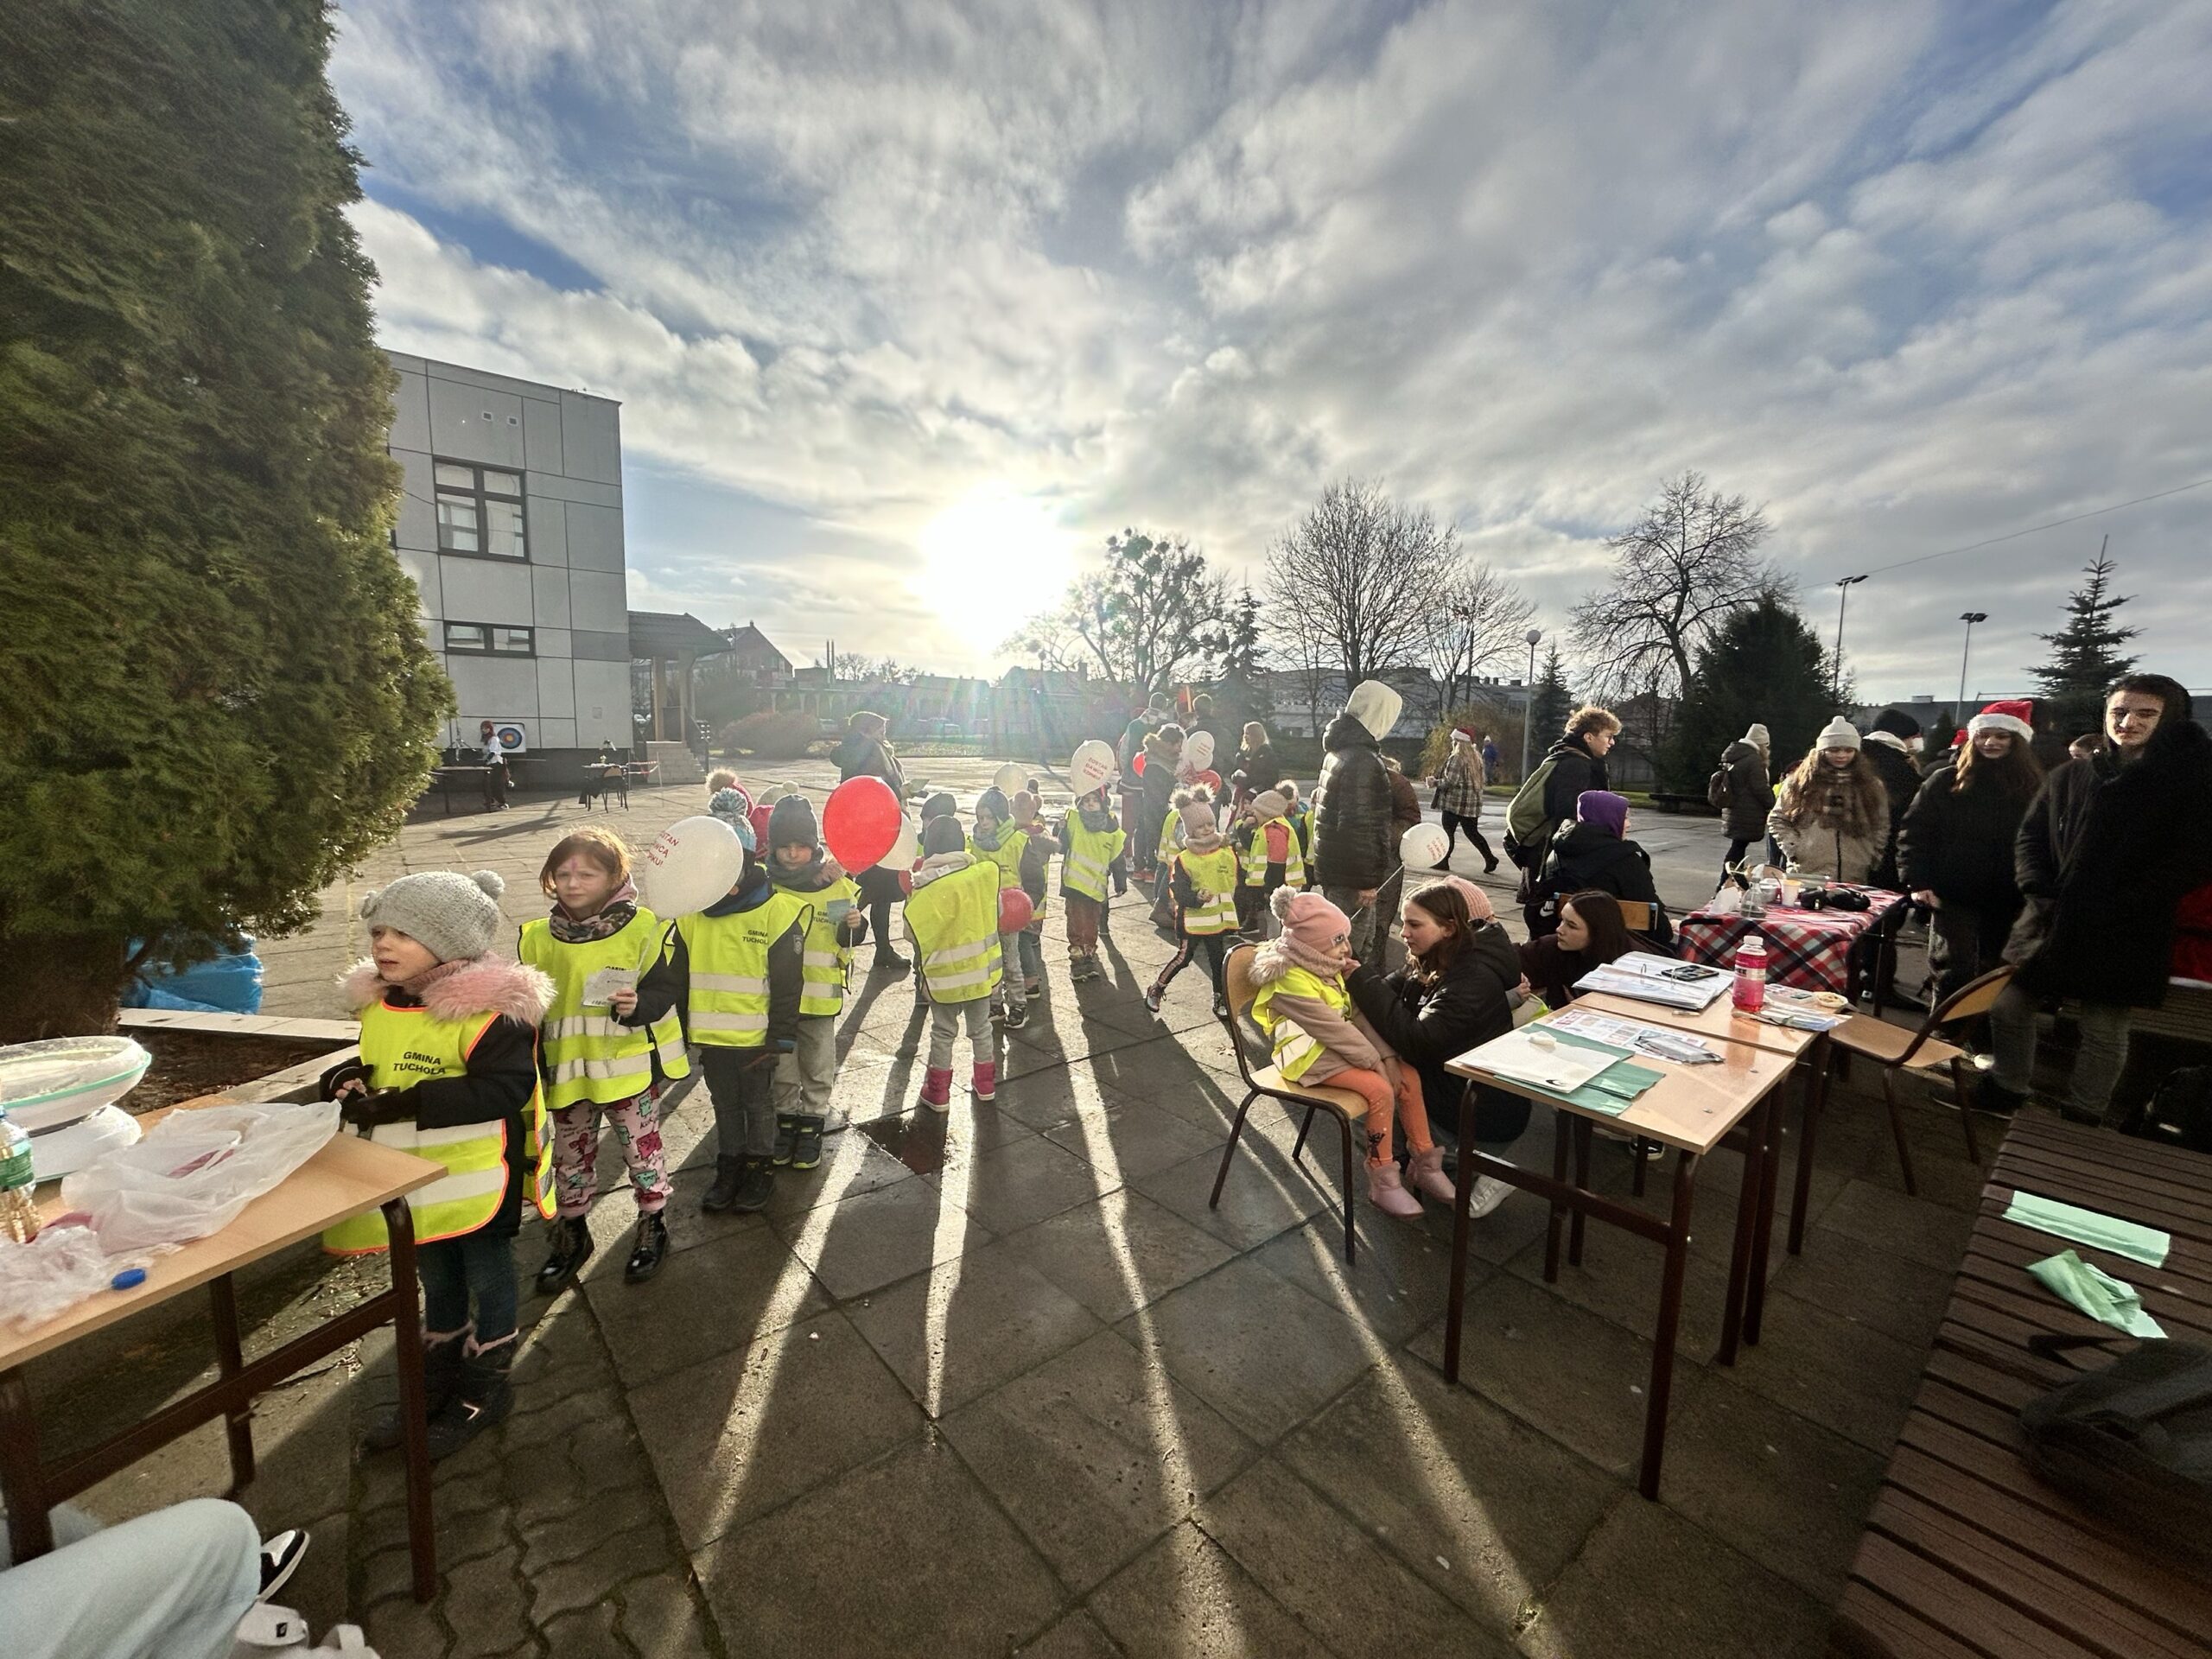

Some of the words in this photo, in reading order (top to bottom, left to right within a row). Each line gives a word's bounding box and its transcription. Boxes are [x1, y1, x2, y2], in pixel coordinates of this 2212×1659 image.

[742, 936, 769, 945] TUCHOL
[404, 1051, 441, 1065] GMINA
[393, 1063, 446, 1075] TUCHOLA
